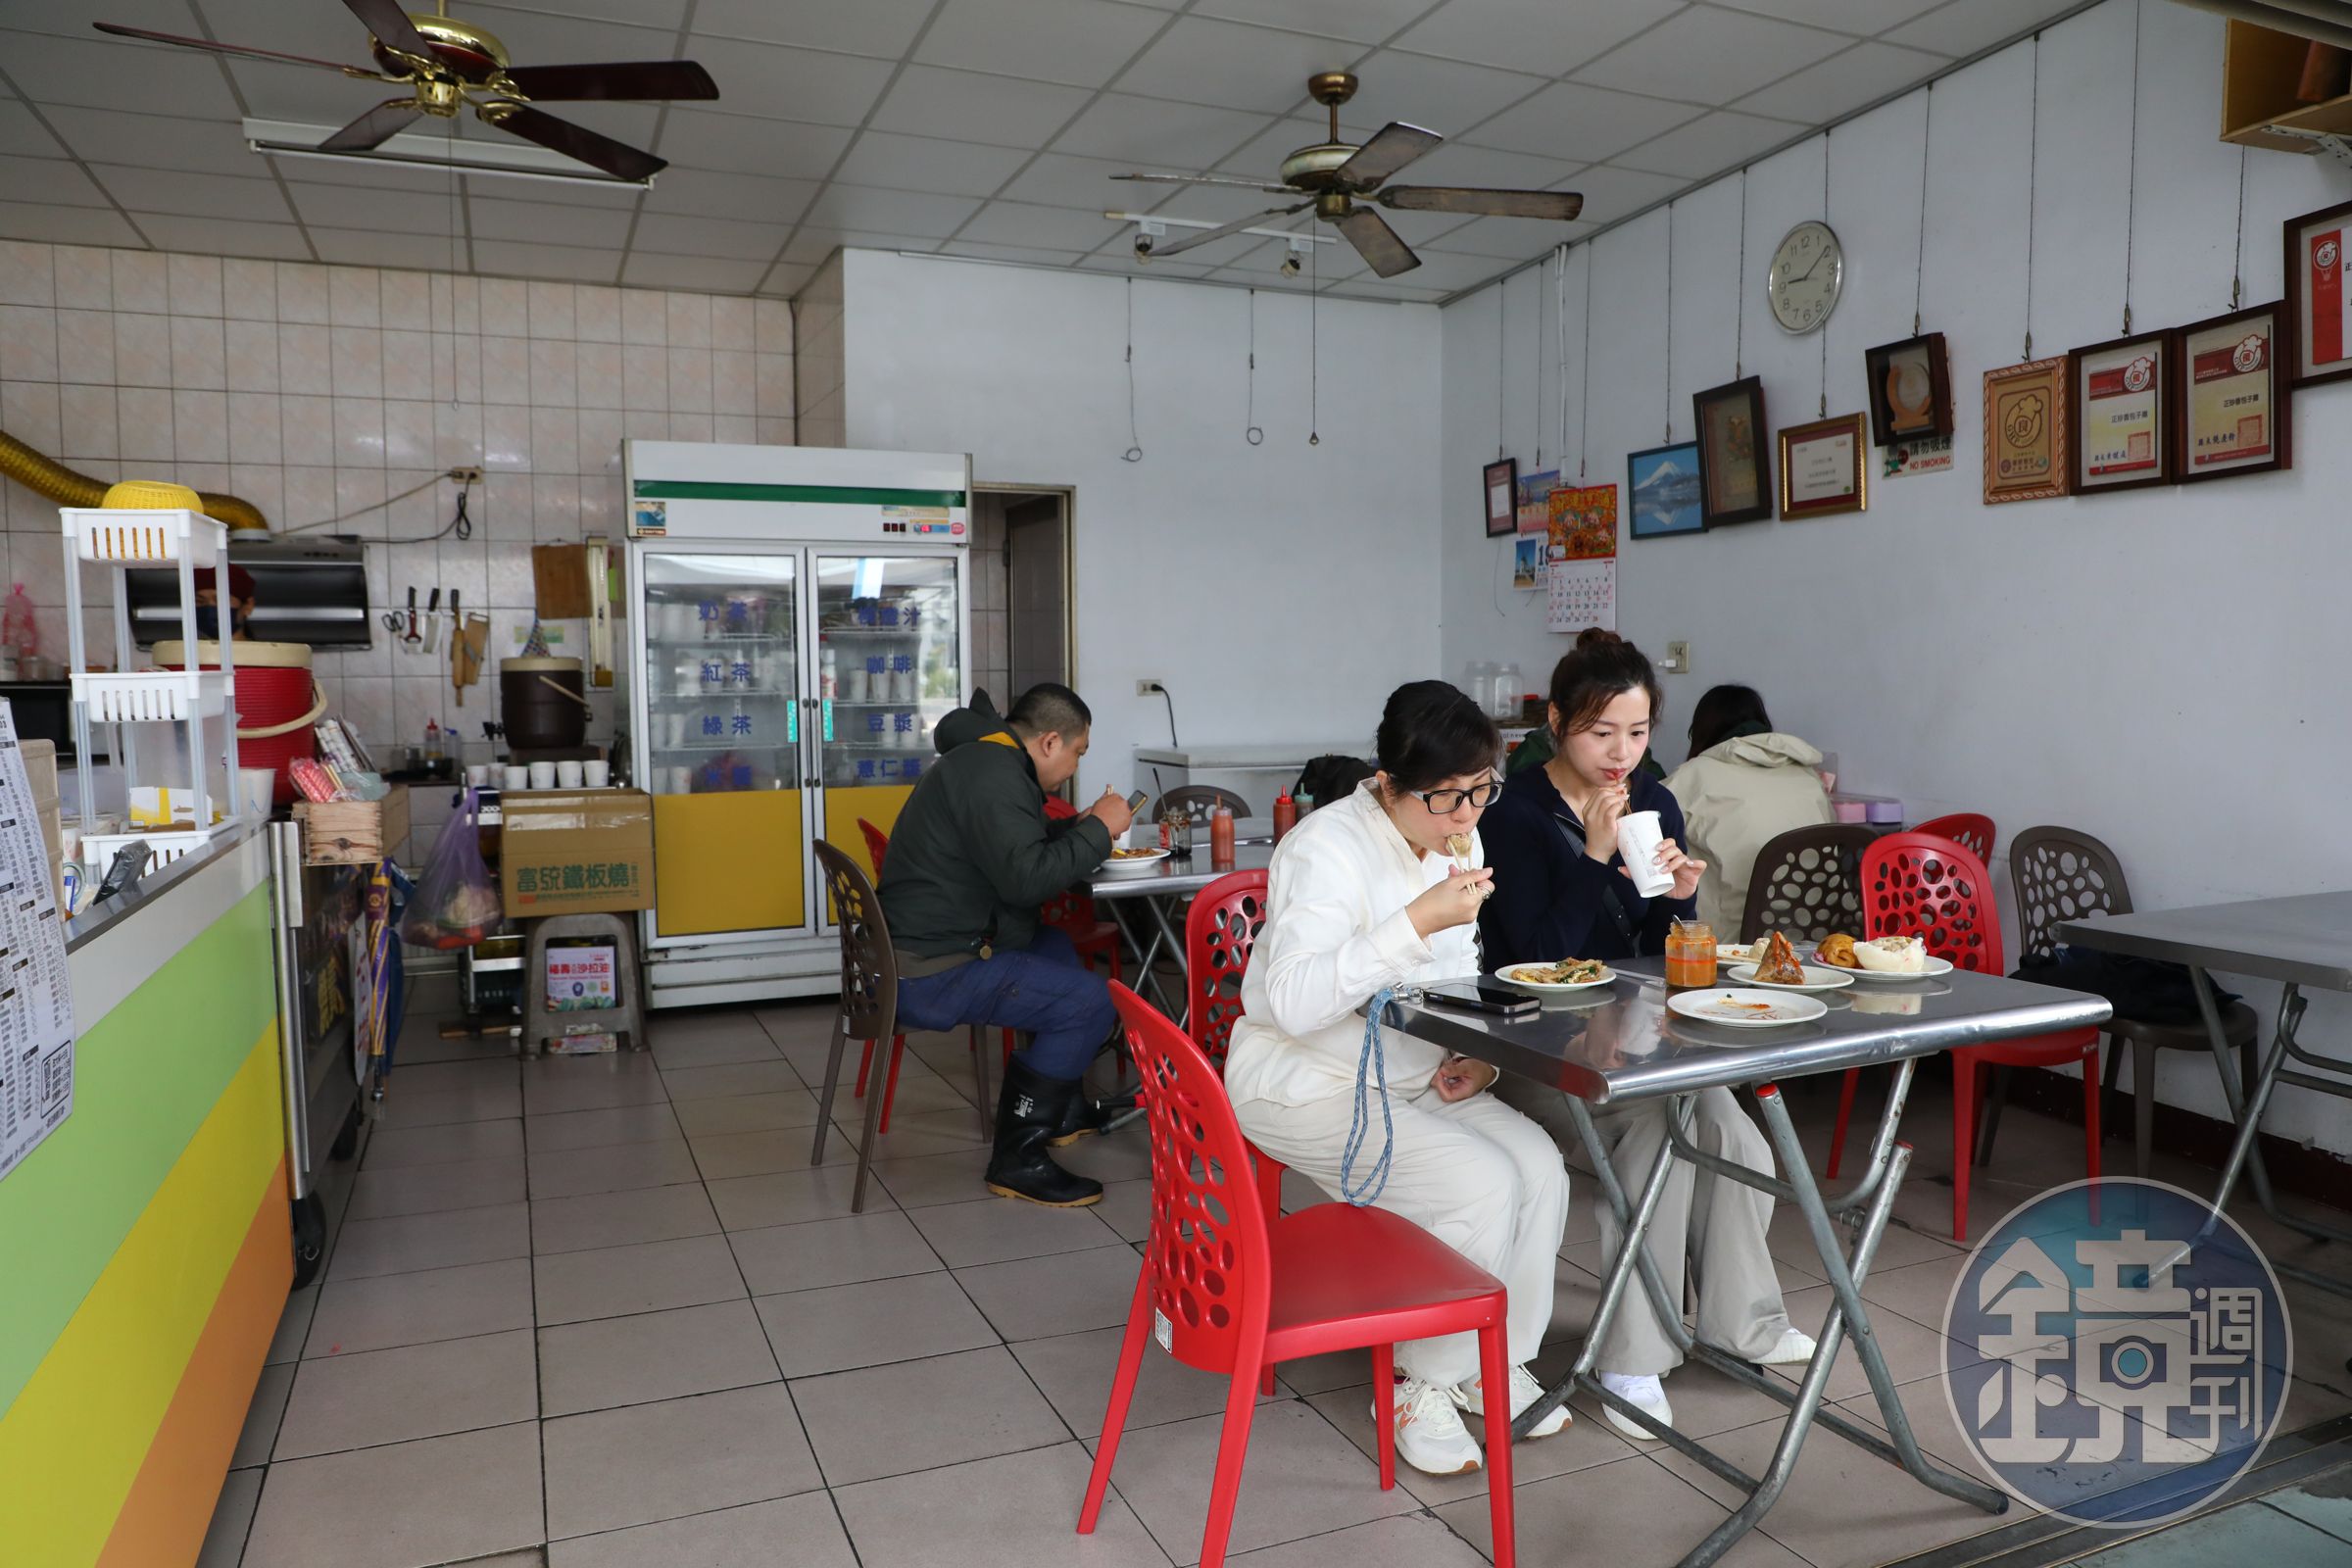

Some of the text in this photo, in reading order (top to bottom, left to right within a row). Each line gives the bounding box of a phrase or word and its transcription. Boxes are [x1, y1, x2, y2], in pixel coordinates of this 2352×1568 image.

[1910, 456, 1950, 470] NO SMOKING
[698, 601, 748, 621] 奶茶
[701, 662, 752, 682] 紅茶
[866, 655, 912, 674] 咖啡
[702, 714, 752, 735] 綠茶
[866, 712, 912, 733] 豆漿
